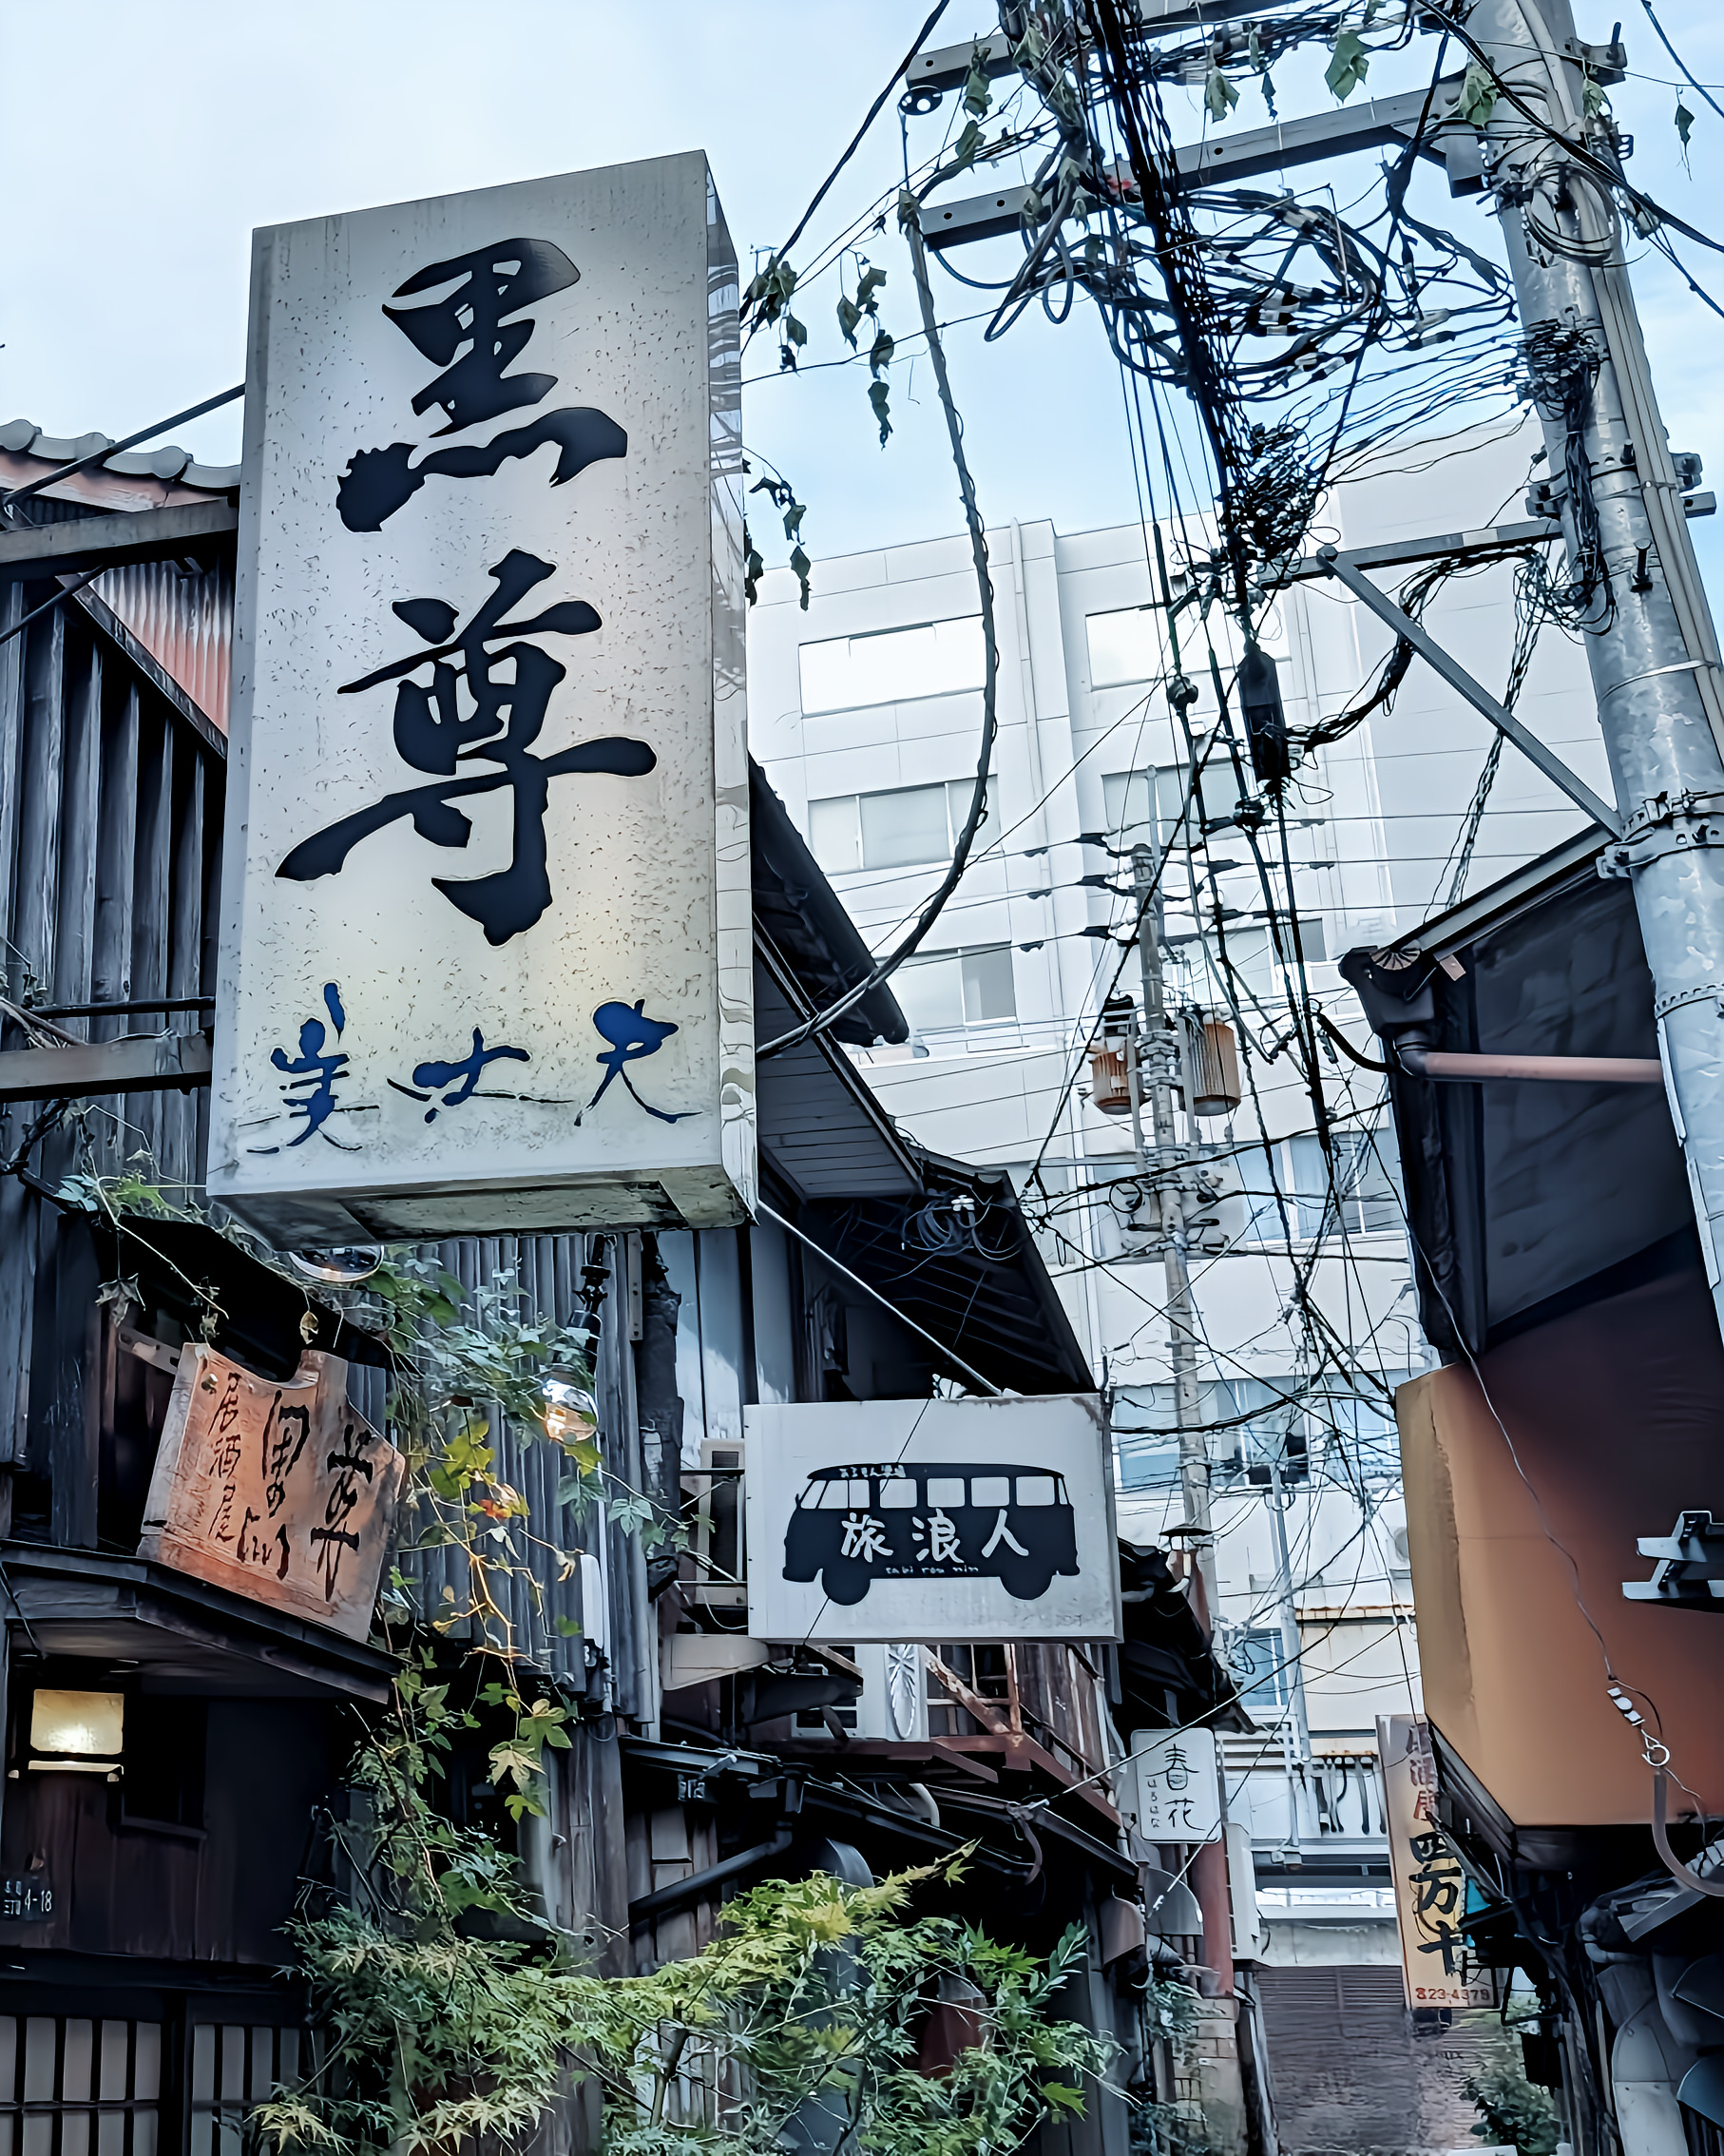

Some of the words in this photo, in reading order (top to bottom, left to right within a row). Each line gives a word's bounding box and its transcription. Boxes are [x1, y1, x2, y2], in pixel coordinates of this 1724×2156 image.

[275, 238, 657, 945] 黒尊
[840, 1508, 1029, 1564] 旅浪人
[1144, 1742, 1206, 1831] 春花
[1408, 1831, 1464, 1976] 四万十
